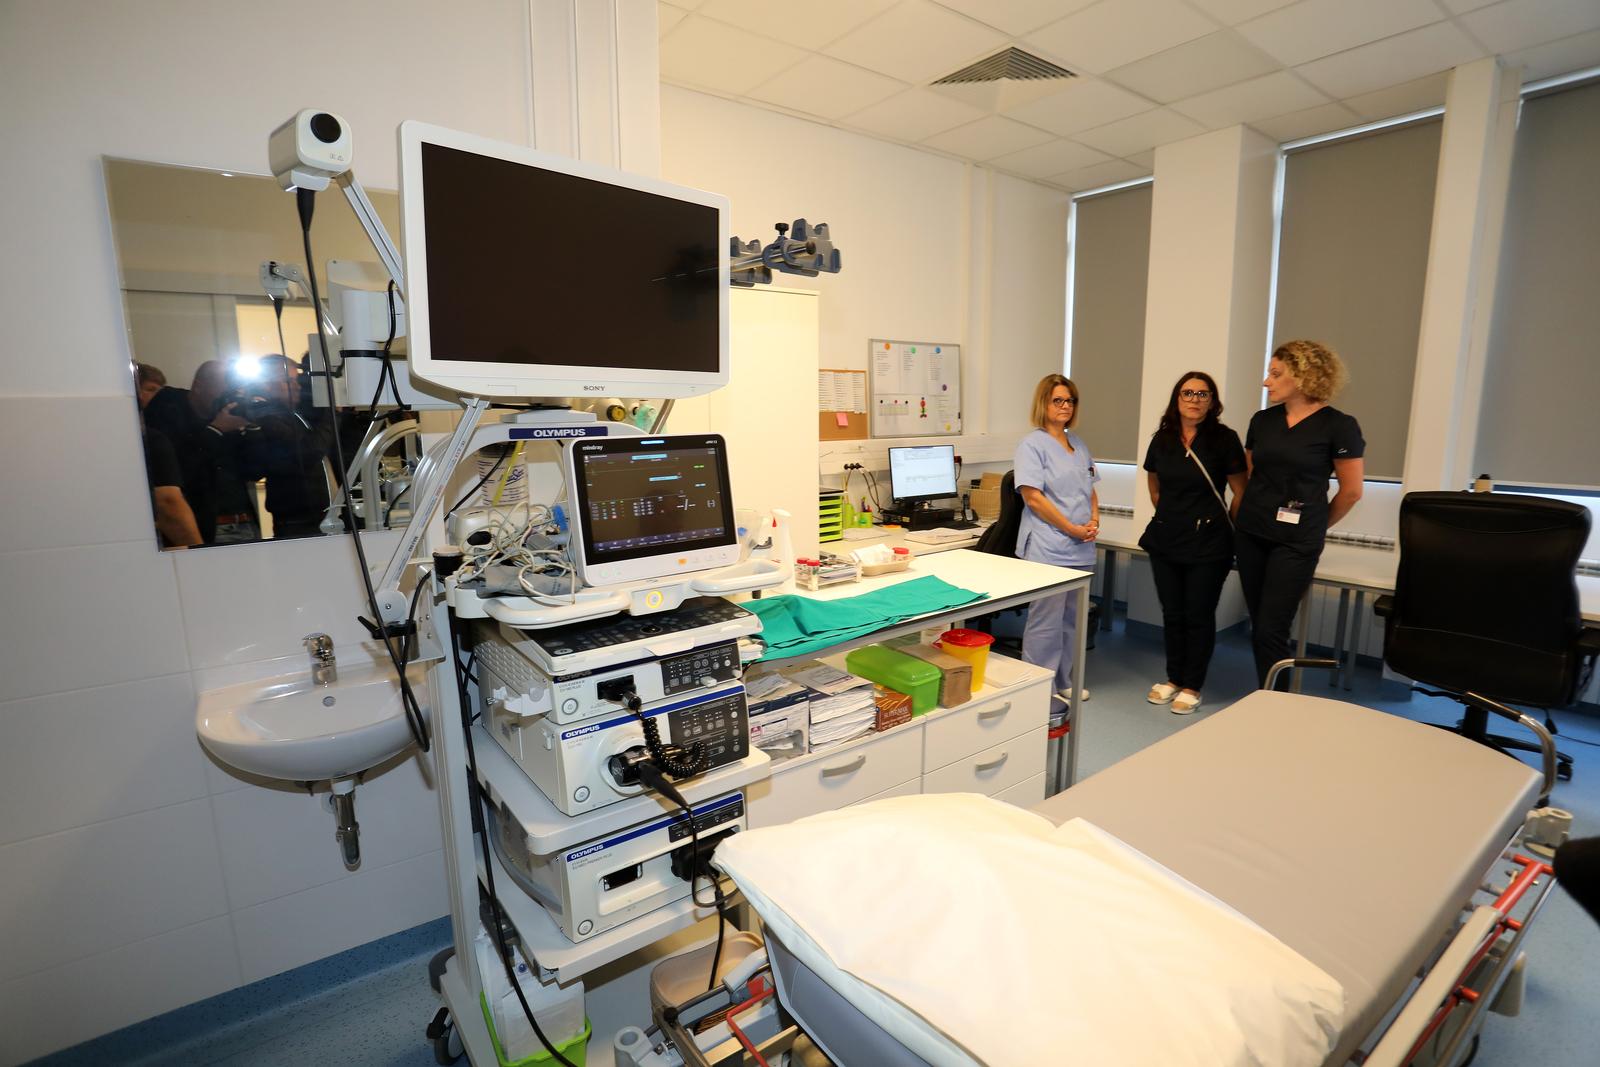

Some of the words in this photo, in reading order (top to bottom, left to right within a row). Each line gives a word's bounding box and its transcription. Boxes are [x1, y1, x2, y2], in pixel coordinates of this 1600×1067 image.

[533, 428, 586, 437] OLYMPUS
[557, 670, 592, 682] OLYMPUS
[565, 725, 600, 738] OLYMPUS
[570, 844, 604, 860] OLYMPUS
